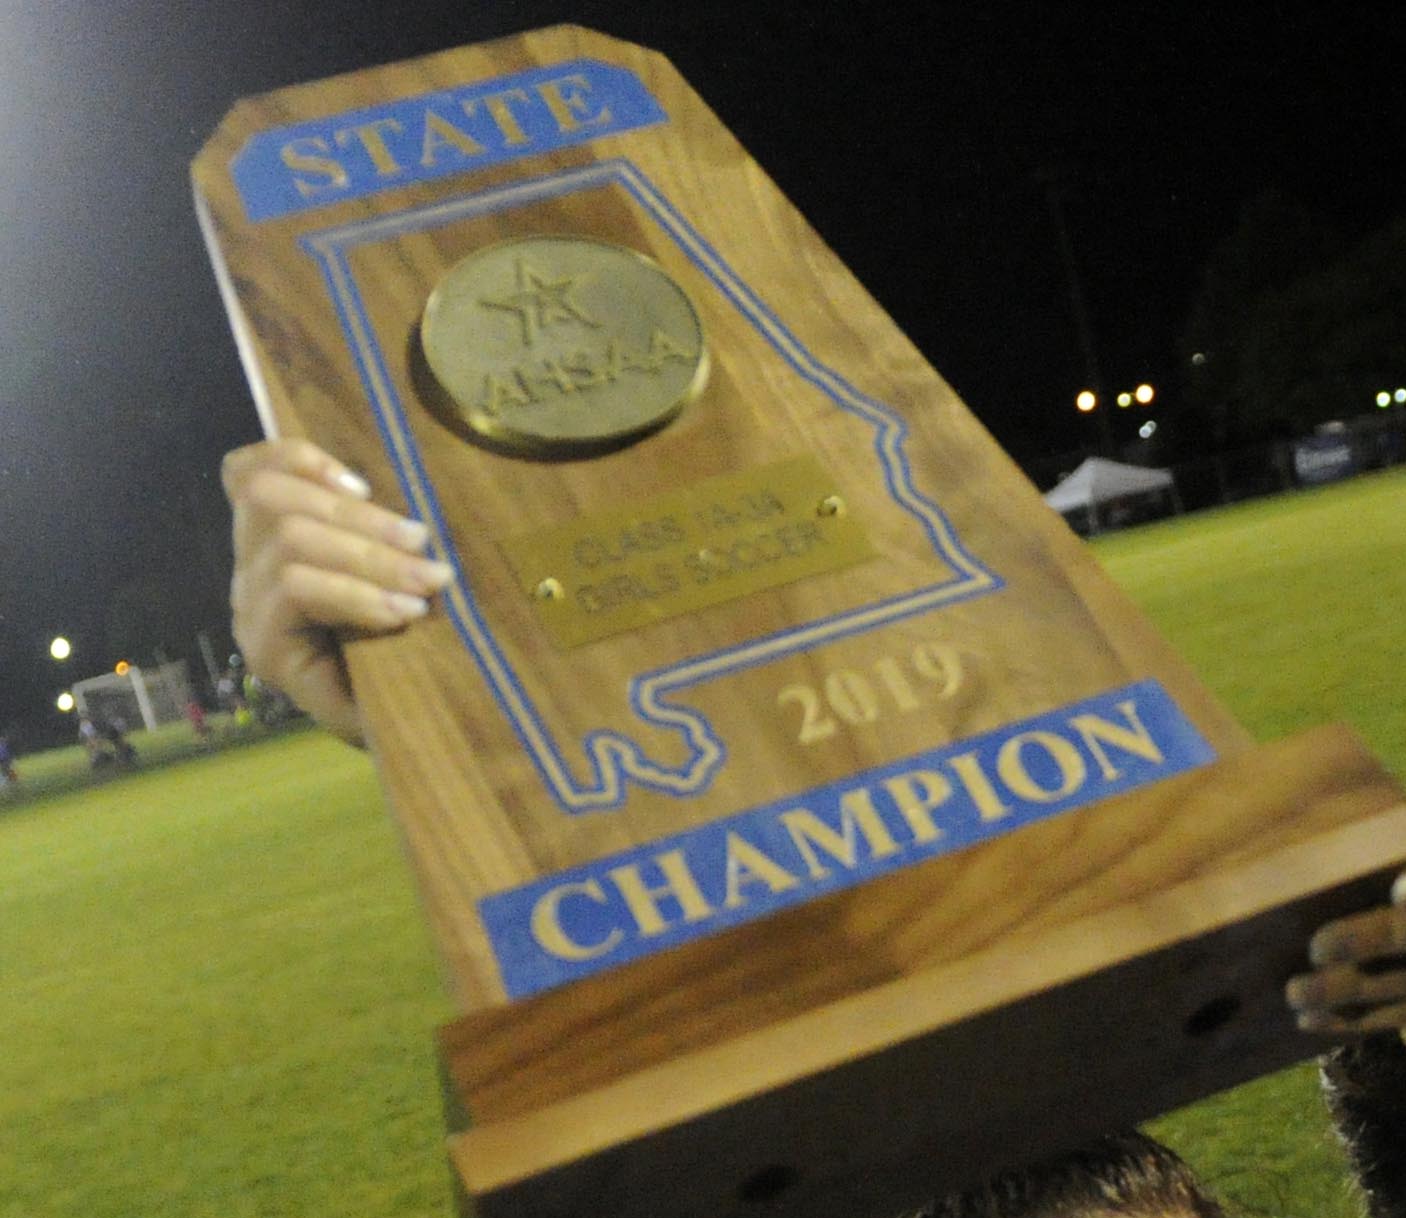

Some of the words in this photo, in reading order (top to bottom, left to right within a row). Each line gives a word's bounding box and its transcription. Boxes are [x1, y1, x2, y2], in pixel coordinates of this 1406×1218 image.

[279, 74, 612, 198] STATE
[778, 641, 970, 745] 2019
[530, 701, 1167, 962] CHAMPION
